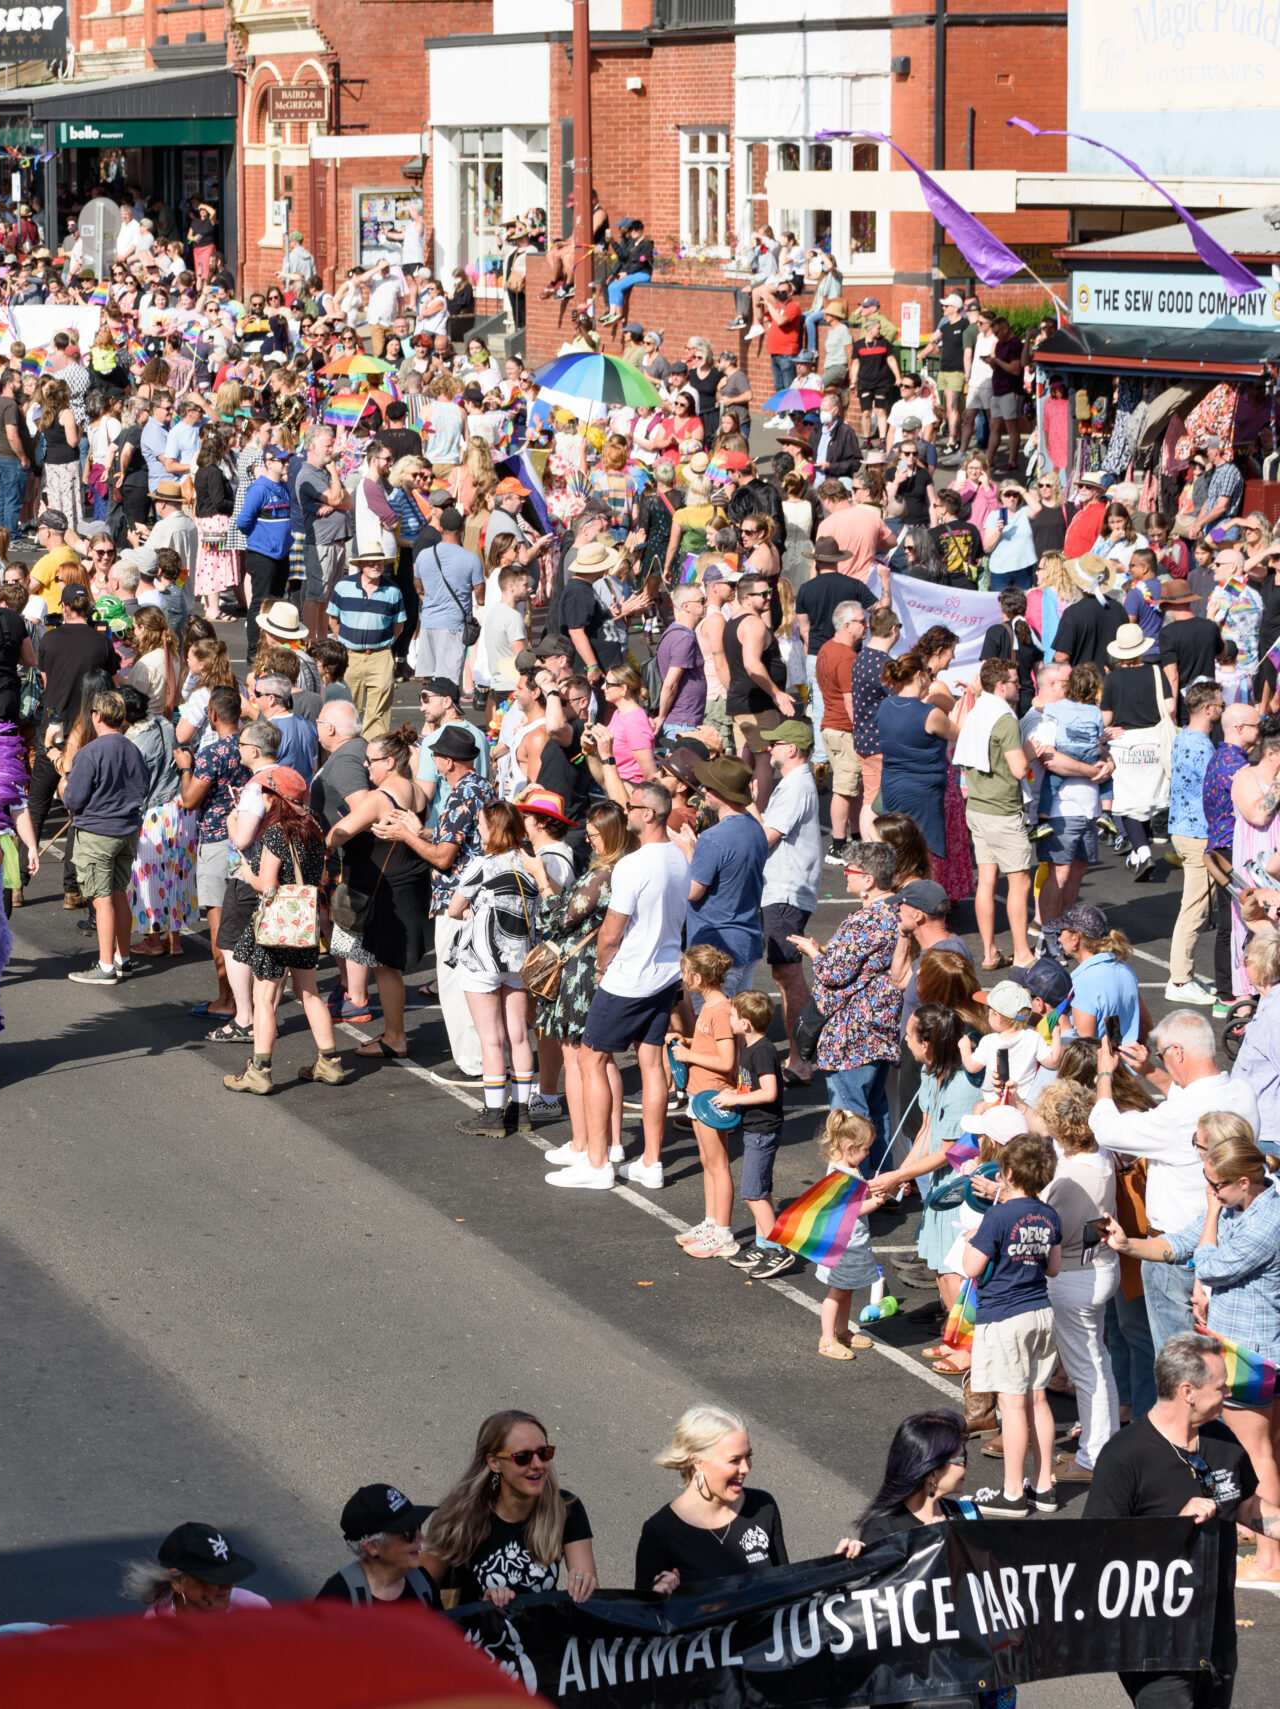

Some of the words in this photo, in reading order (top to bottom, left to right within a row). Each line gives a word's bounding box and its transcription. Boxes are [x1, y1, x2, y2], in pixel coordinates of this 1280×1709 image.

[1131, 0, 1207, 51] Magic
[1213, 0, 1280, 52] Pudd
[12, 48, 38, 56] FRUIT
[1096, 36, 1127, 88] The
[1146, 63, 1266, 85] HOMEWARES
[281, 90, 308, 99] BAIRD
[309, 91, 316, 99] &
[275, 101, 323, 110] McGREGOR
[69, 124, 100, 140] belle
[1094, 289, 1120, 311] THE
[1124, 289, 1153, 312] SEW
[1158, 290, 1194, 314] GOOD
[1198, 292, 1267, 317] COMPANY
[1019, 1226, 1051, 1244] DEUS
[1007, 1243, 1051, 1256] CUSTOM
[557, 1620, 745, 1697] ANIMAL
[764, 1576, 961, 1663] JUSTICE
[1096, 1558, 1195, 1620] ORG
